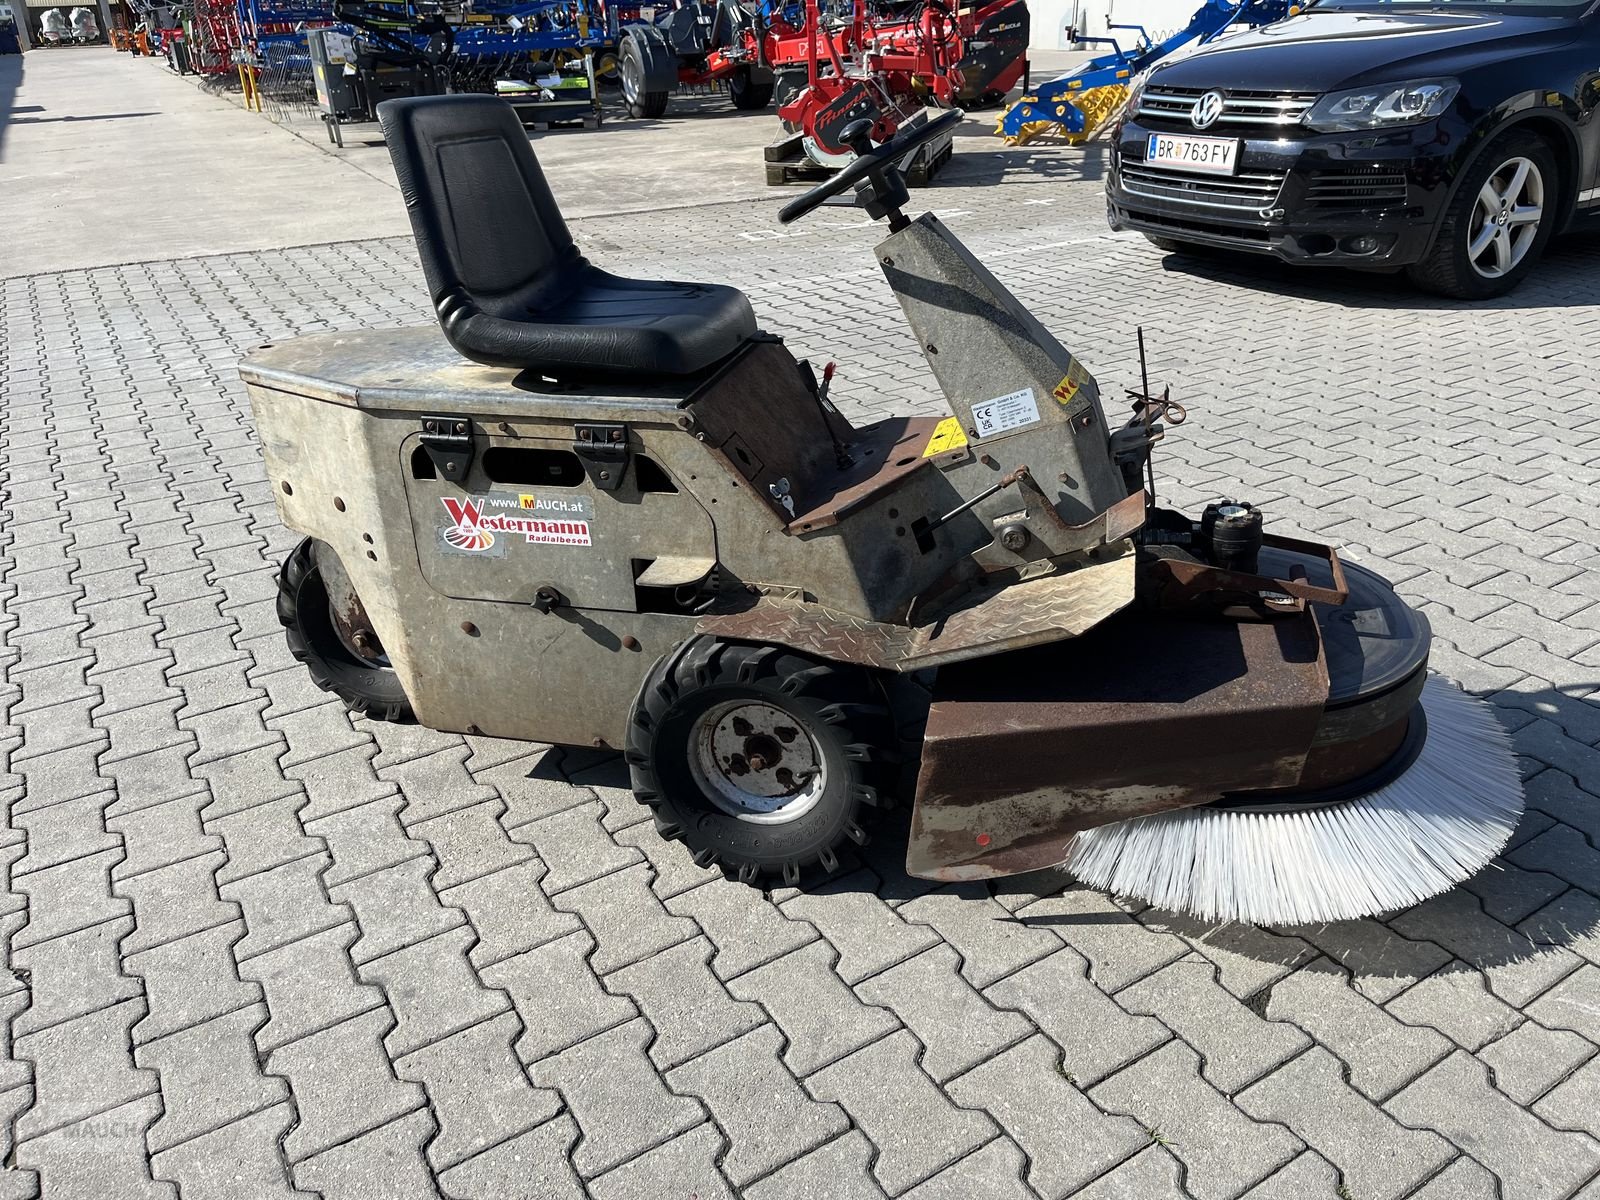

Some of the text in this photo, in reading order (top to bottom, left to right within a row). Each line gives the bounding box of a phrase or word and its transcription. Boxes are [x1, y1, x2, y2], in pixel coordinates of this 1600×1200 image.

[1158, 140, 1231, 165] BR 763 FV
[490, 498, 583, 512] www.MAUCH.at
[443, 498, 588, 535] Westermann
[528, 534, 589, 545] Radialbesen
